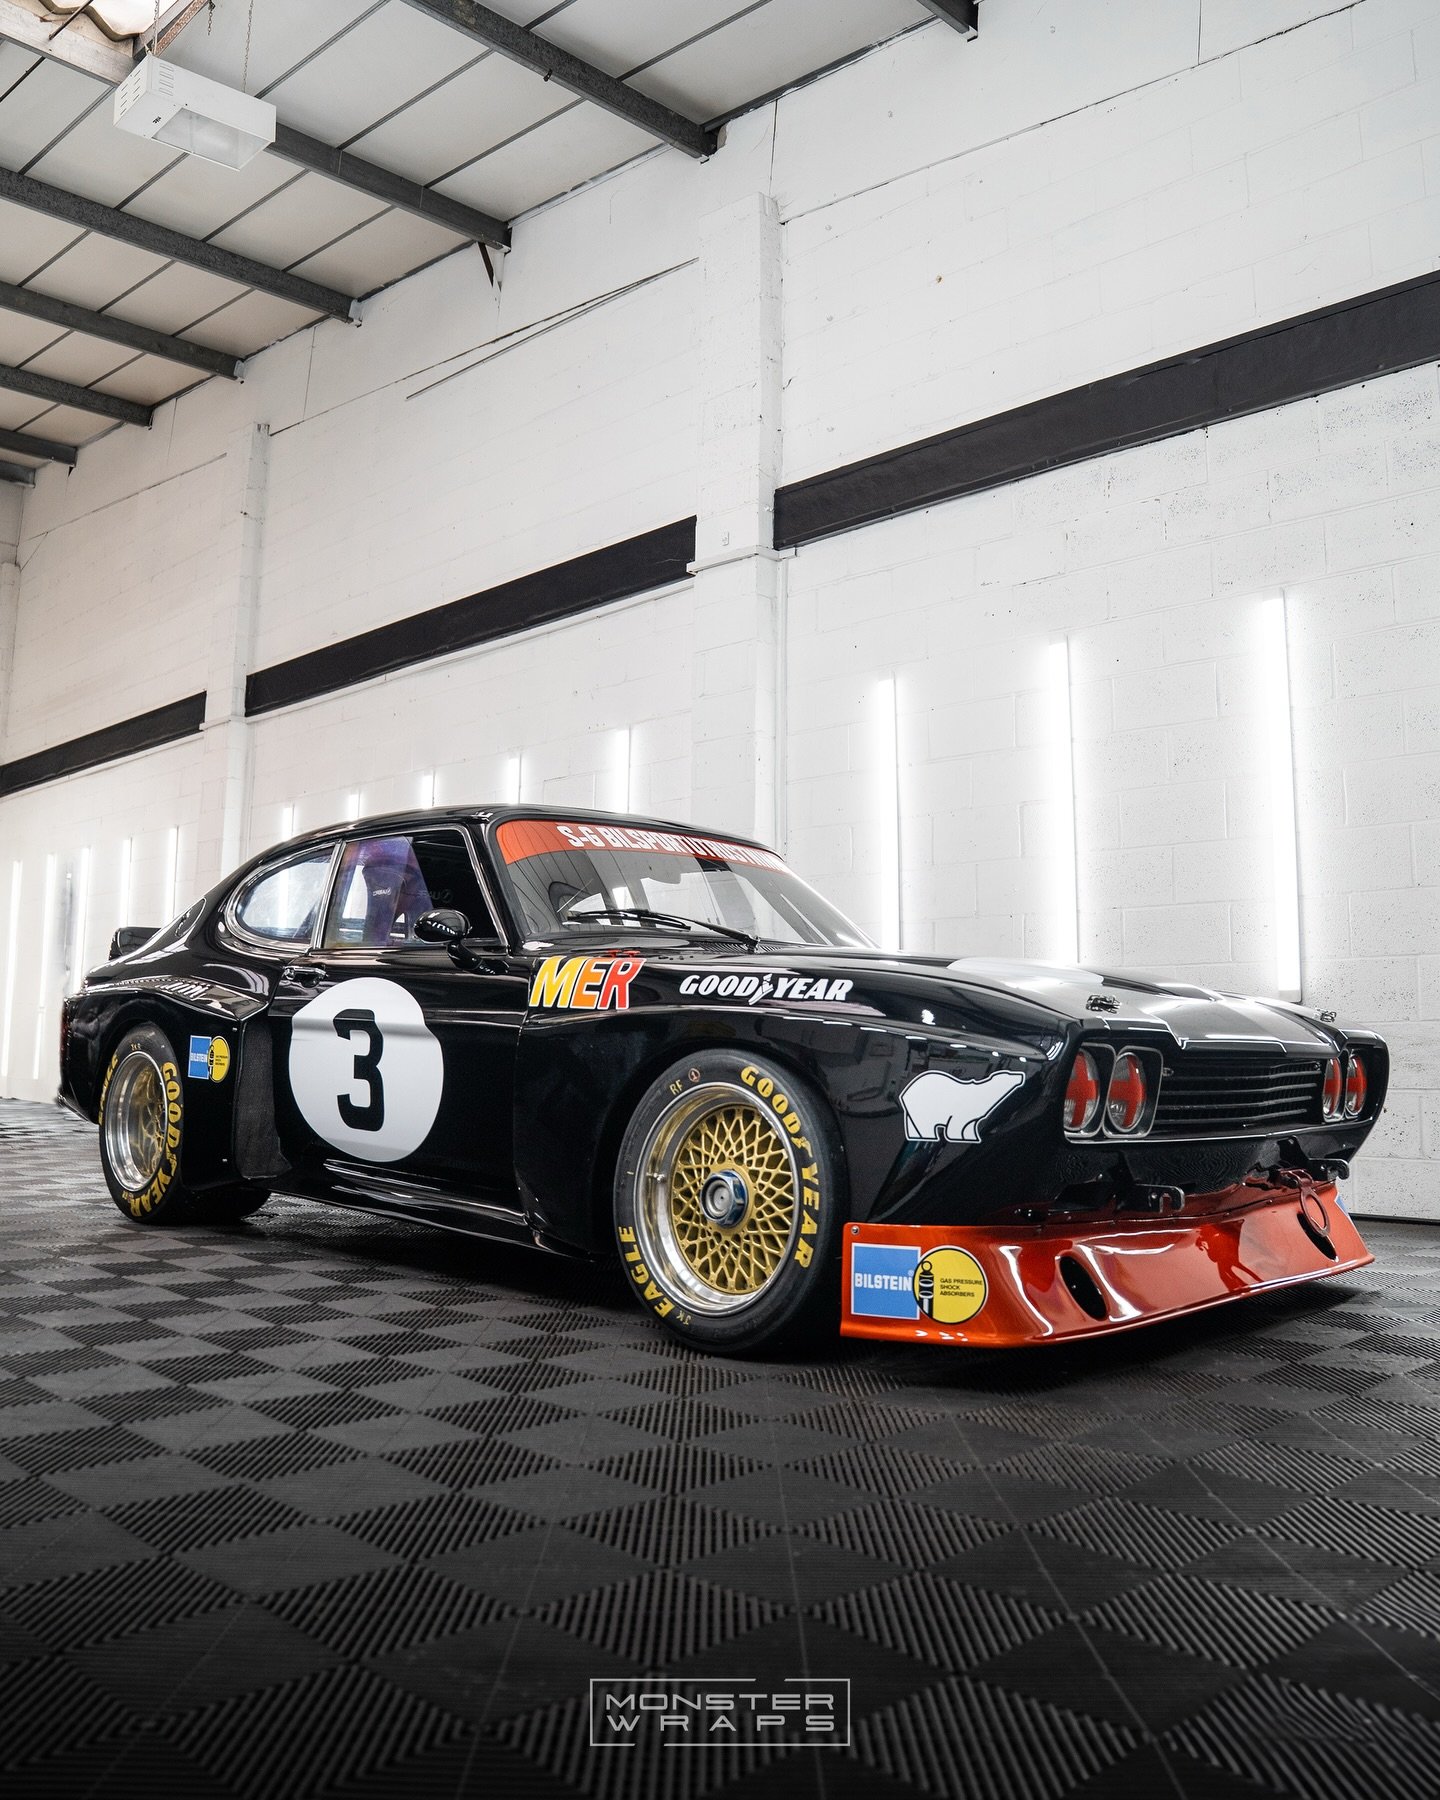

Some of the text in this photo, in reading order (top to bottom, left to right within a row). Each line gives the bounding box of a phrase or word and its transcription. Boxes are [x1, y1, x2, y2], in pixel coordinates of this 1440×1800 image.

[556, 825, 605, 848] S-G
[529, 955, 647, 1010] MER
[679, 973, 854, 1006] GOODYEAR
[333, 1008, 386, 1132] 3
[740, 1066, 821, 1270] GOODYEAR
[618, 1225, 675, 1319] EAGLE
[854, 1272, 913, 1292] BILSTEIN
[953, 1278, 983, 1286] PRESSURE
